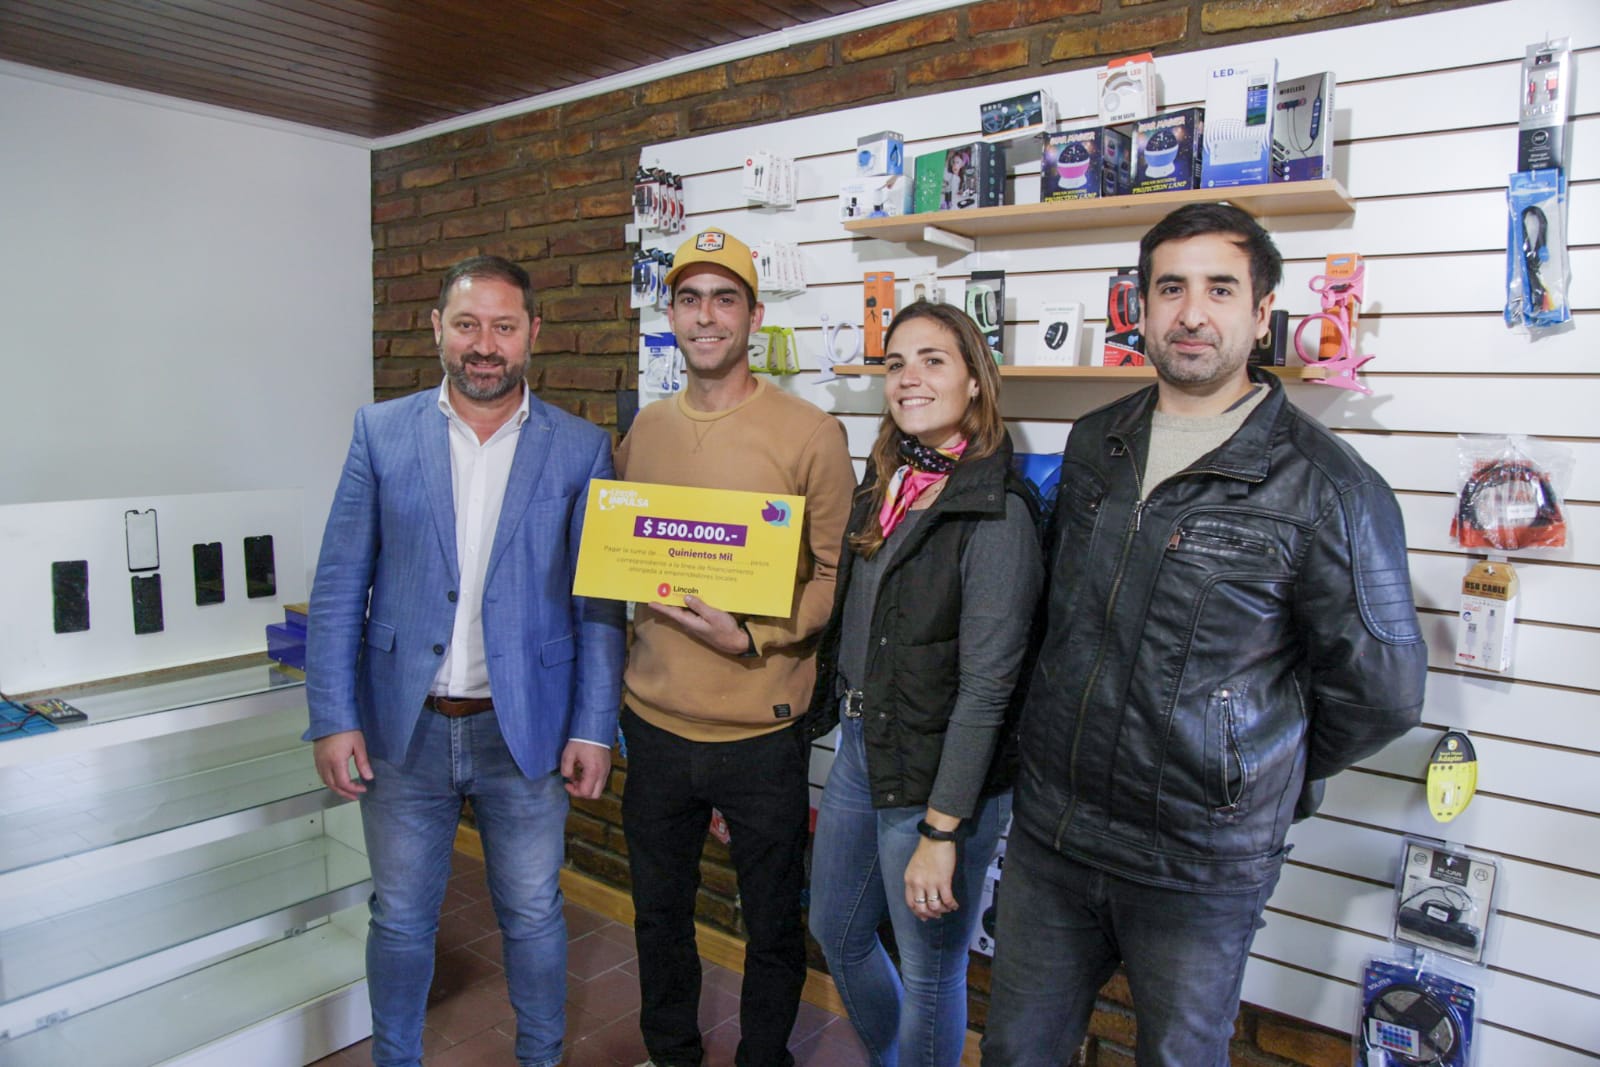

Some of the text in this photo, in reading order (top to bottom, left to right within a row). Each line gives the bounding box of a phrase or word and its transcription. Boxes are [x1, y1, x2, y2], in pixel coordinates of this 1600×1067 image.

[1212, 68, 1234, 78] LED
[1279, 85, 1305, 95] WIRELESS
[1168, 180, 1187, 189] LAMP
[643, 519, 738, 541] $ 500.000.-
[604, 545, 621, 553] Pagar
[668, 547, 717, 560] Quinientos
[719, 552, 733, 561] Mil
[673, 585, 699, 594] Lincoln
[1465, 581, 1480, 591] USB
[1482, 584, 1505, 594] CABLE
